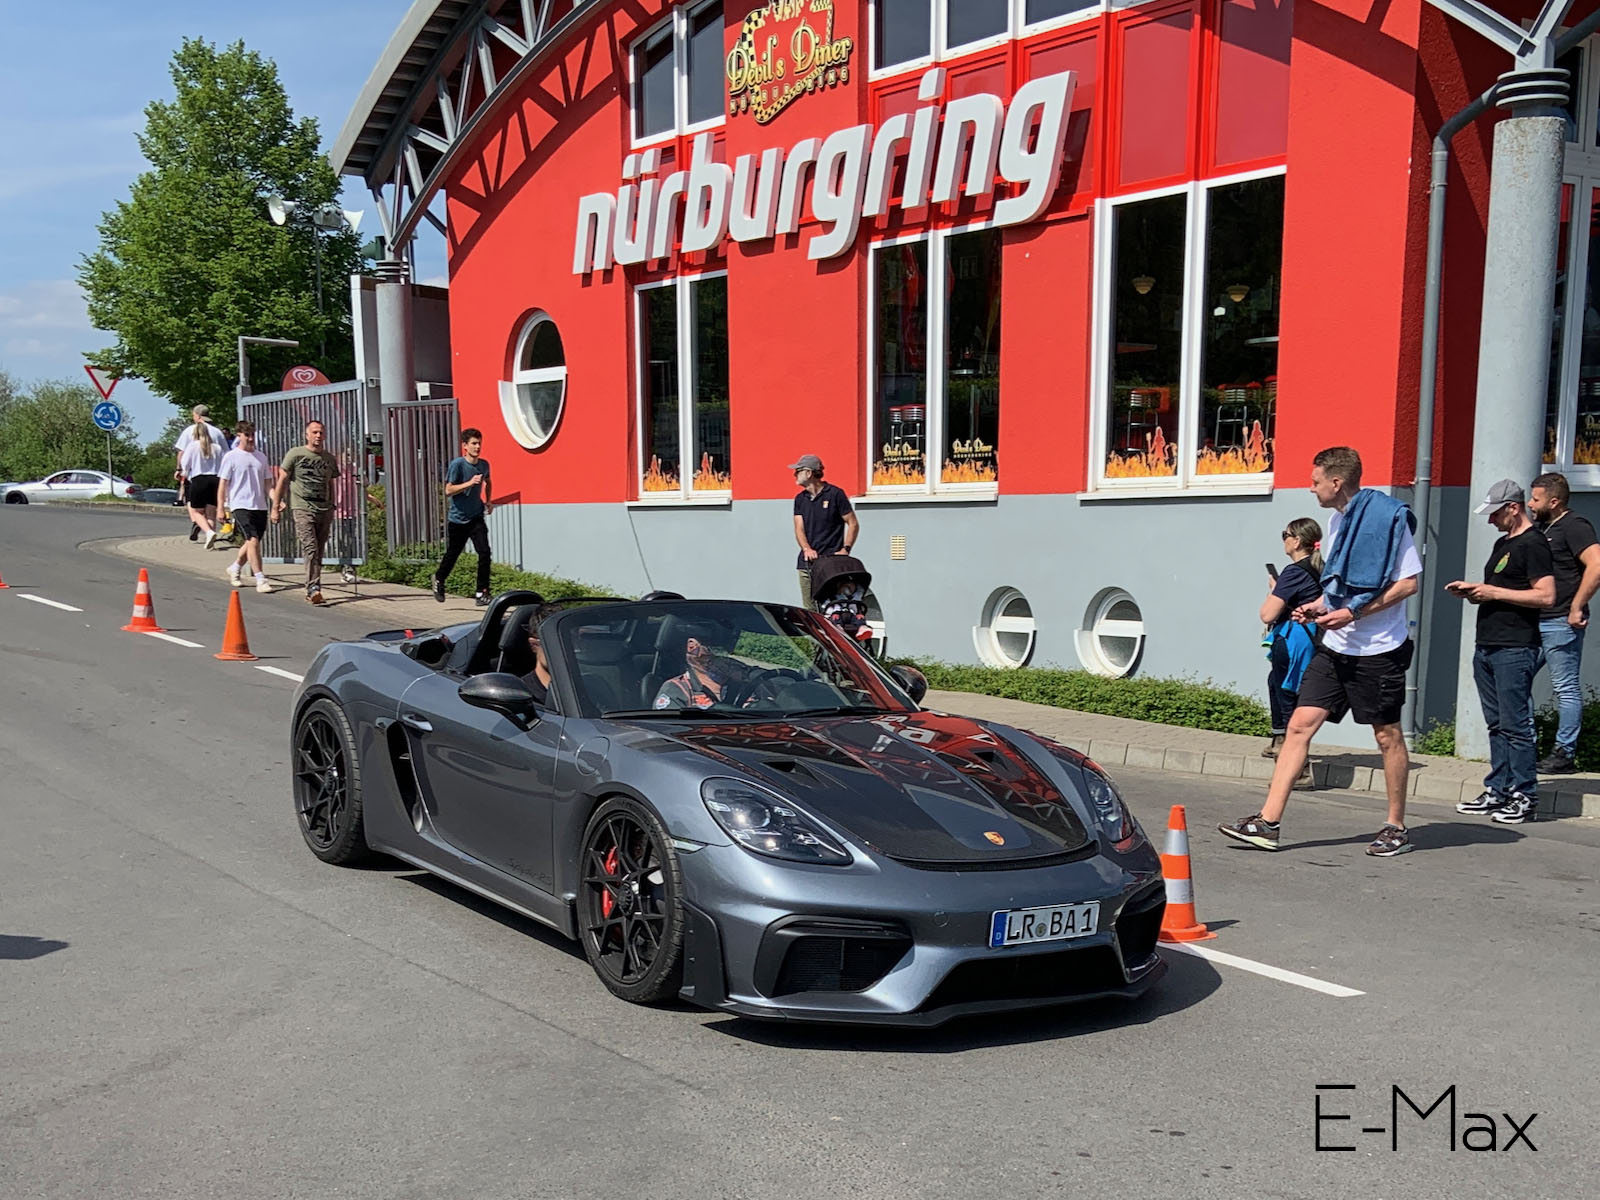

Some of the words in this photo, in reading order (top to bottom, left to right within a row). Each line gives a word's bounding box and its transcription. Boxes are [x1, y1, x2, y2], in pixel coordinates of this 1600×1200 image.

[726, 36, 785, 95] Devil's
[791, 18, 852, 75] Diner
[572, 68, 1078, 275] nürburgring
[1006, 913, 1035, 941] LR
[1050, 910, 1076, 936] BA
[1080, 907, 1093, 933] 1
